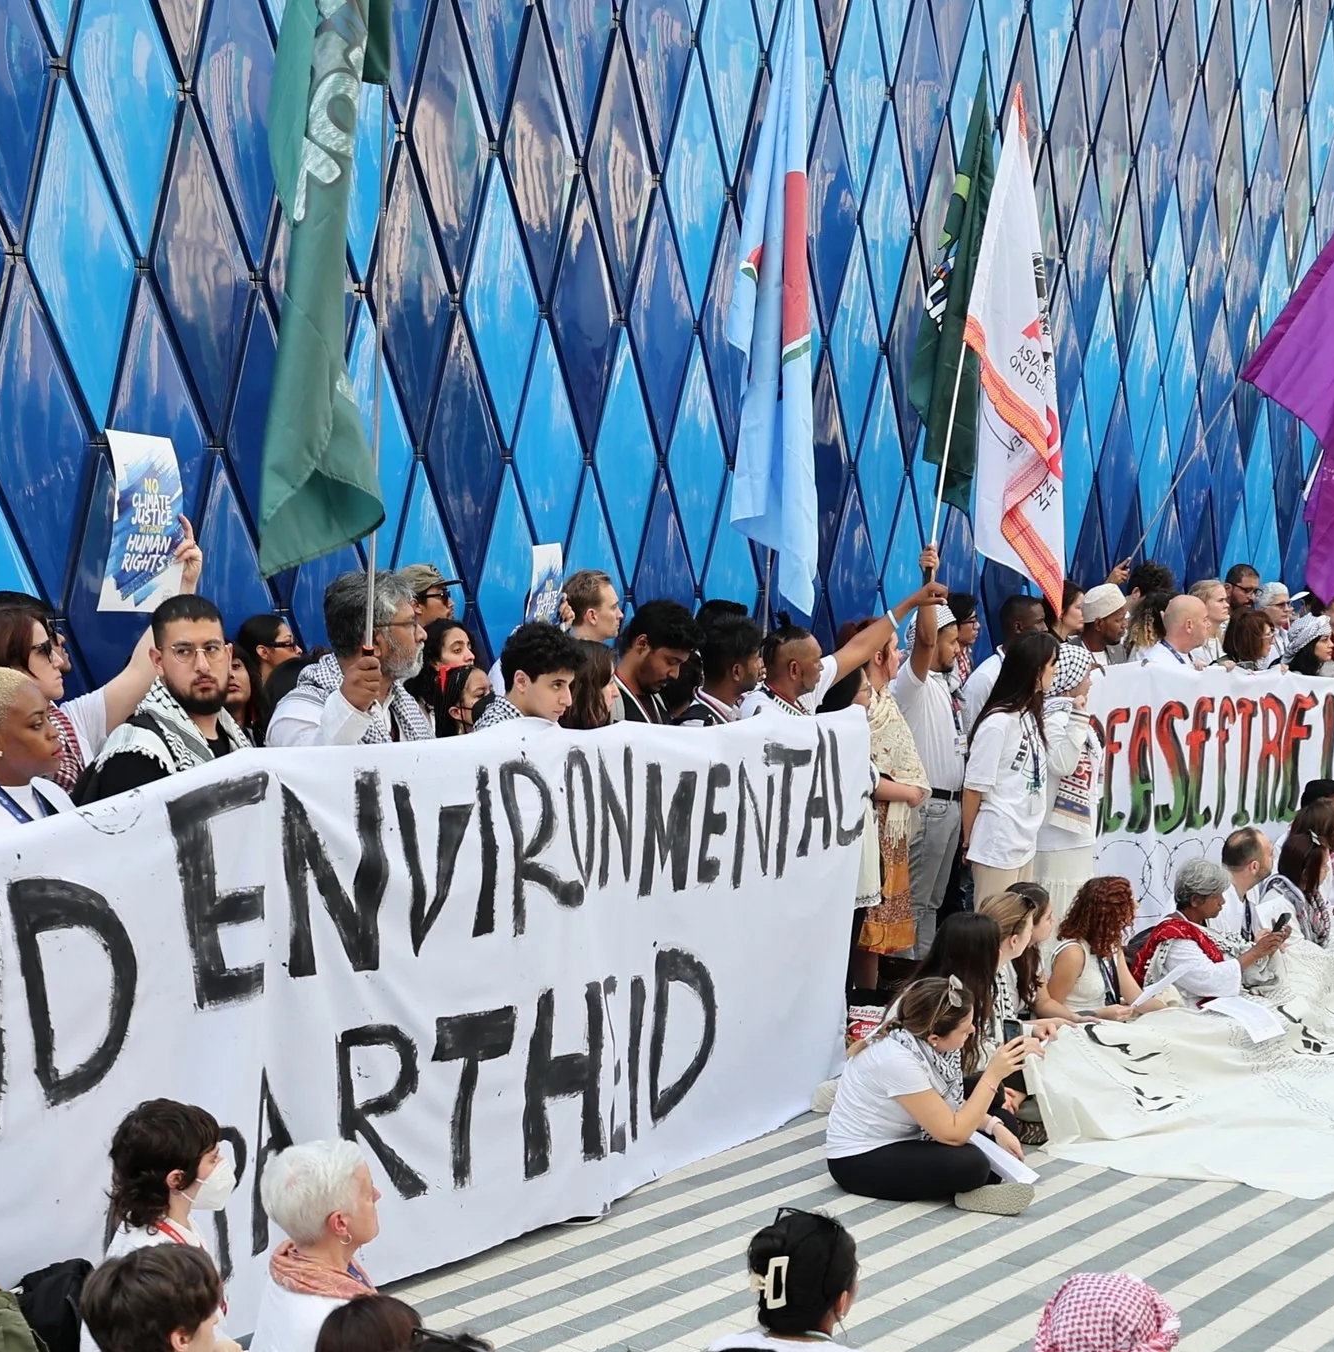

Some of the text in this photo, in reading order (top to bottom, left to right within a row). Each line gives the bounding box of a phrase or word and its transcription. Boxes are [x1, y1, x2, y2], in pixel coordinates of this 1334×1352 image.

[1009, 355, 1028, 377] ON
[144, 478, 159, 493] NO
[132, 492, 171, 510] CLIMATE
[131, 508, 173, 526] JUSTICE
[139, 525, 165, 534] WITHOUT
[126, 533, 172, 553] HUMAN
[121, 553, 167, 573] RIGHTS
[166, 724, 866, 1011] ENVIRONMENTAL
